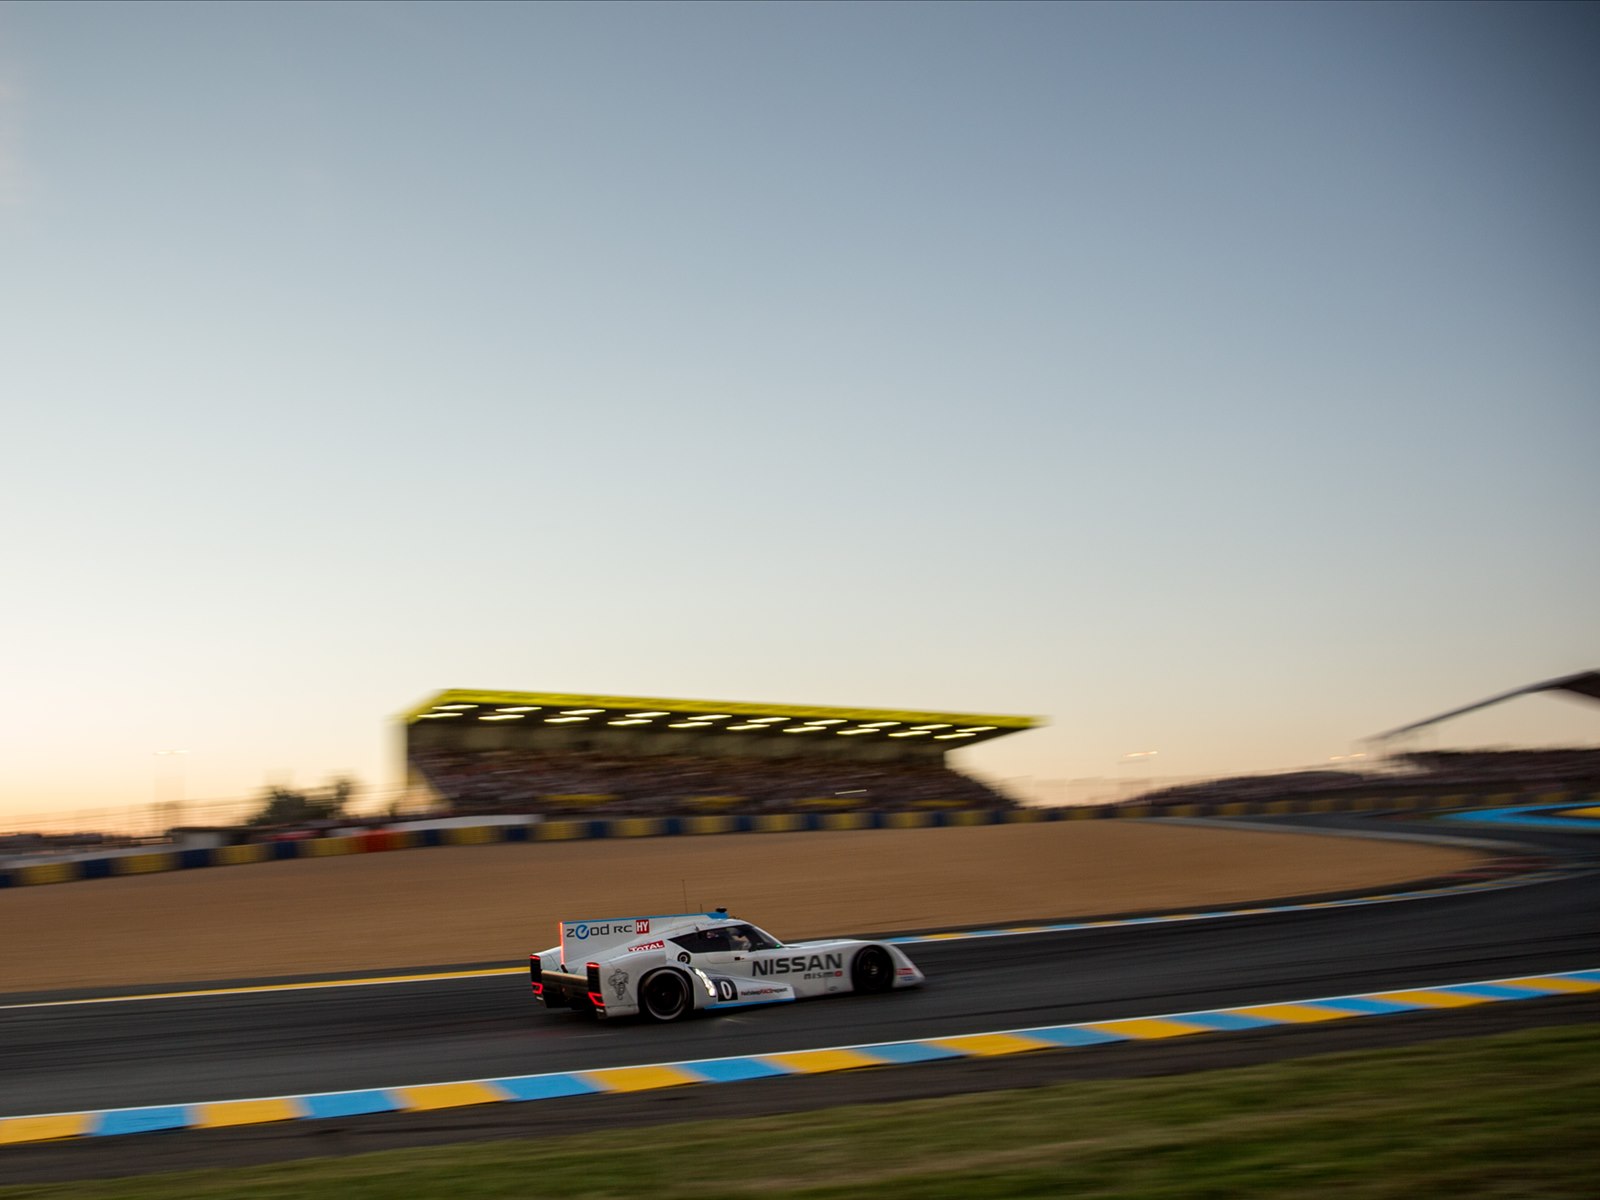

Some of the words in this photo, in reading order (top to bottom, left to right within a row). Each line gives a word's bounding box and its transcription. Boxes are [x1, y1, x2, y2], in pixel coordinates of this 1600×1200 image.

[613, 924, 633, 933] RC
[636, 920, 649, 933] HY
[630, 942, 664, 951] TOTAL
[752, 953, 842, 977] NISSAN
[720, 980, 732, 1000] 0
